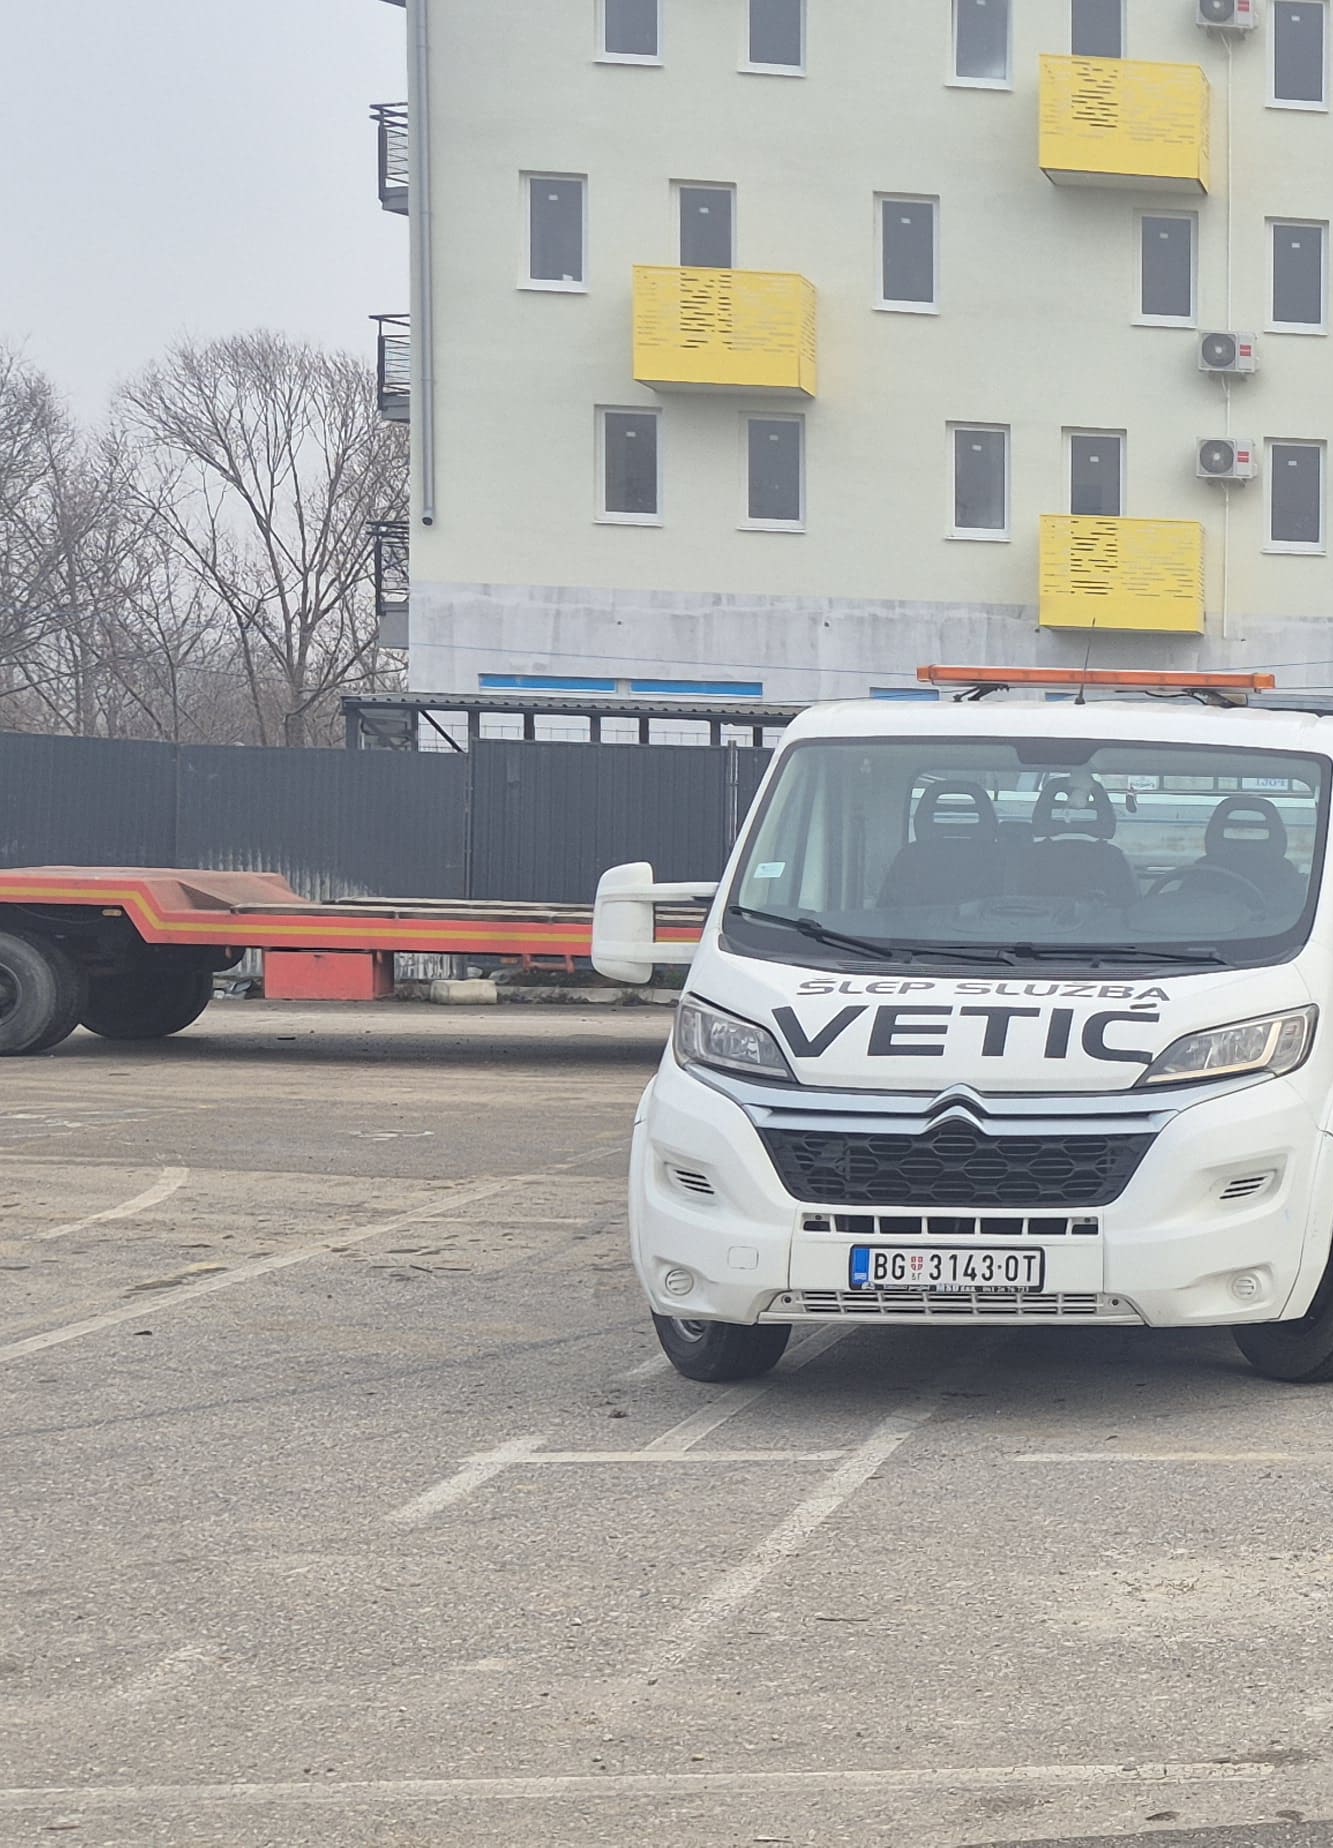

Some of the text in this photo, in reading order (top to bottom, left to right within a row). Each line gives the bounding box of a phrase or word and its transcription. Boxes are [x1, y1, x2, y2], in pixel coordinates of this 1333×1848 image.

[796, 978, 1171, 1001] ŠLEP SLUŽBA
[771, 1002, 1161, 1065] VETIĆ
[874, 1253, 906, 1280] BG
